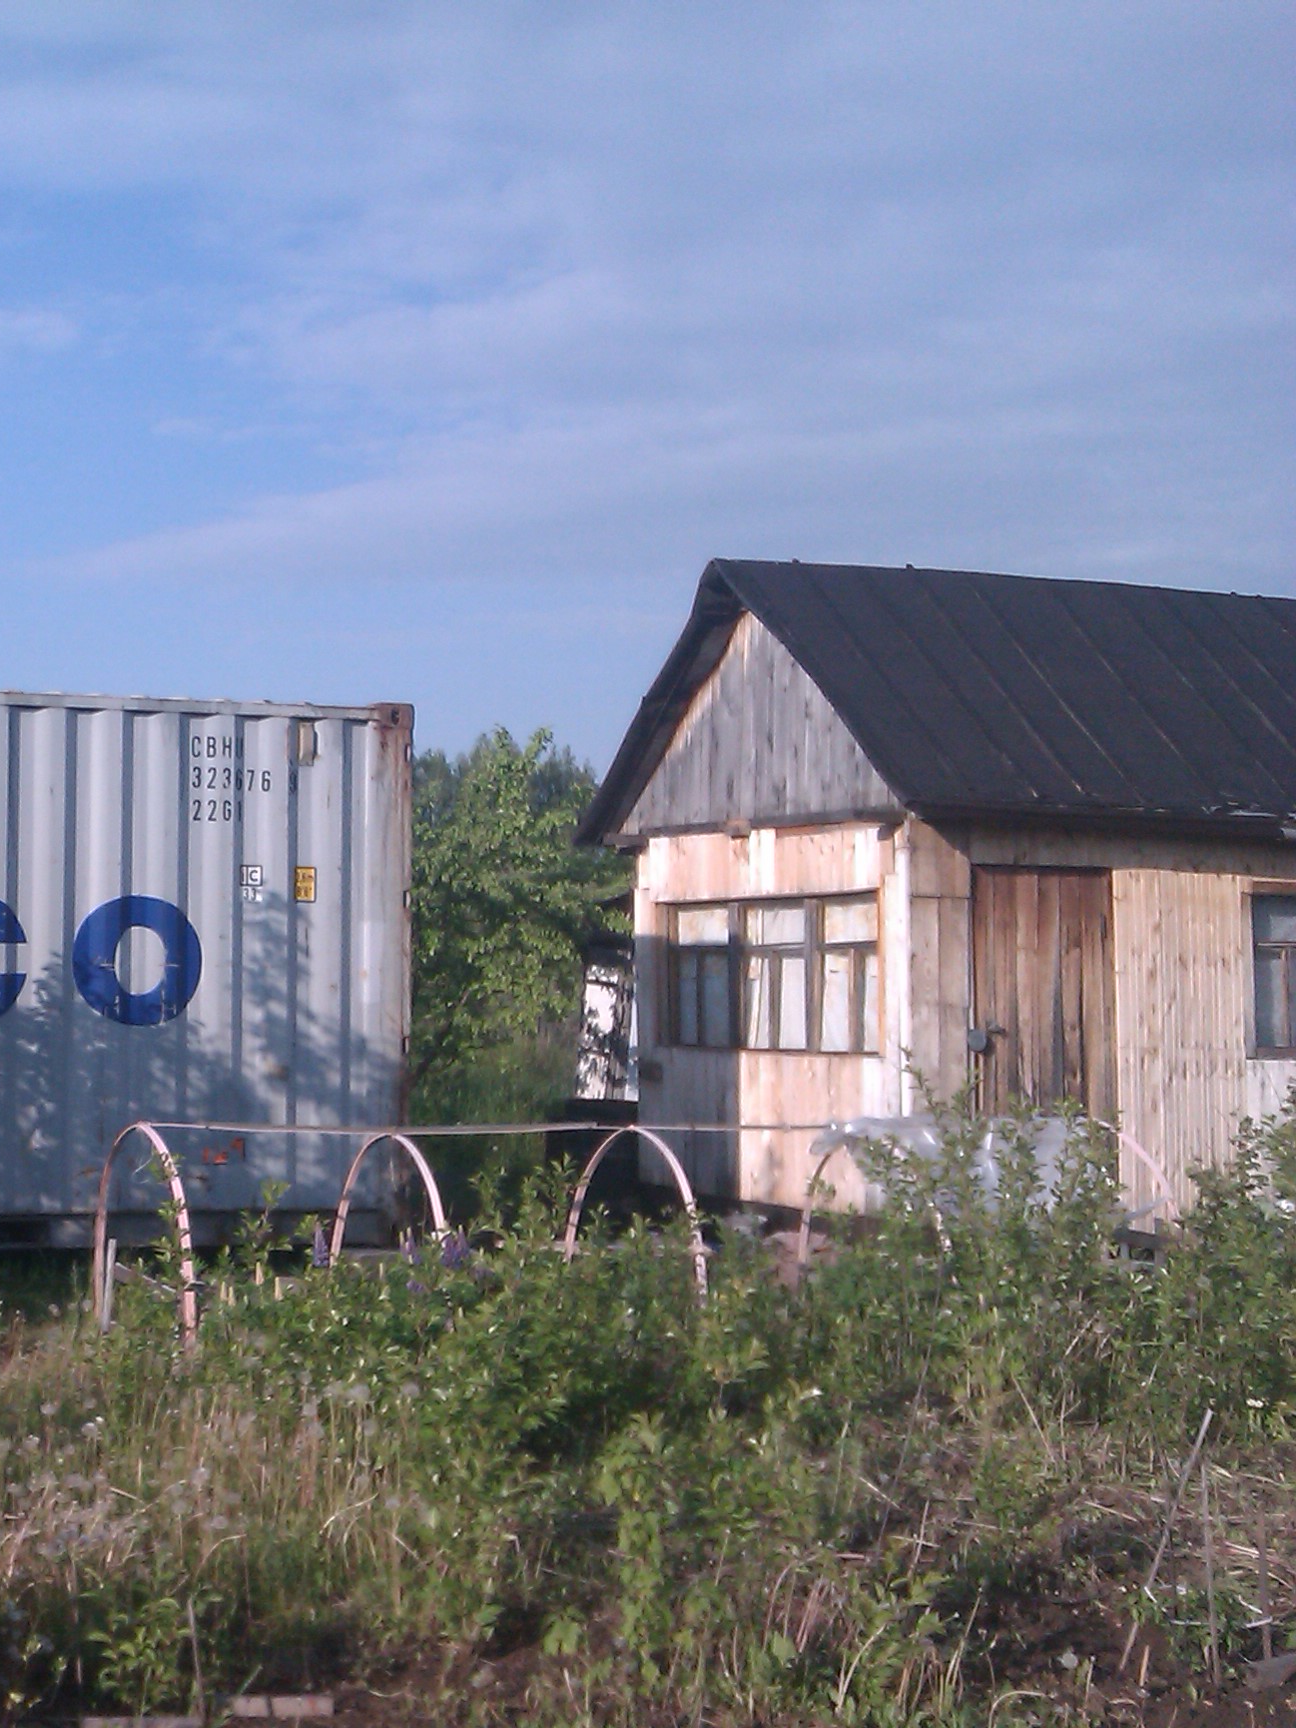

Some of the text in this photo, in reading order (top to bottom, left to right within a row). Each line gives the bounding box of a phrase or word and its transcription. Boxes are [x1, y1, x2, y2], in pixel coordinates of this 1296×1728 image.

[191, 735, 244, 759] CBHU
[191, 766, 271, 792] 323676
[192, 799, 242, 821] 22G1
